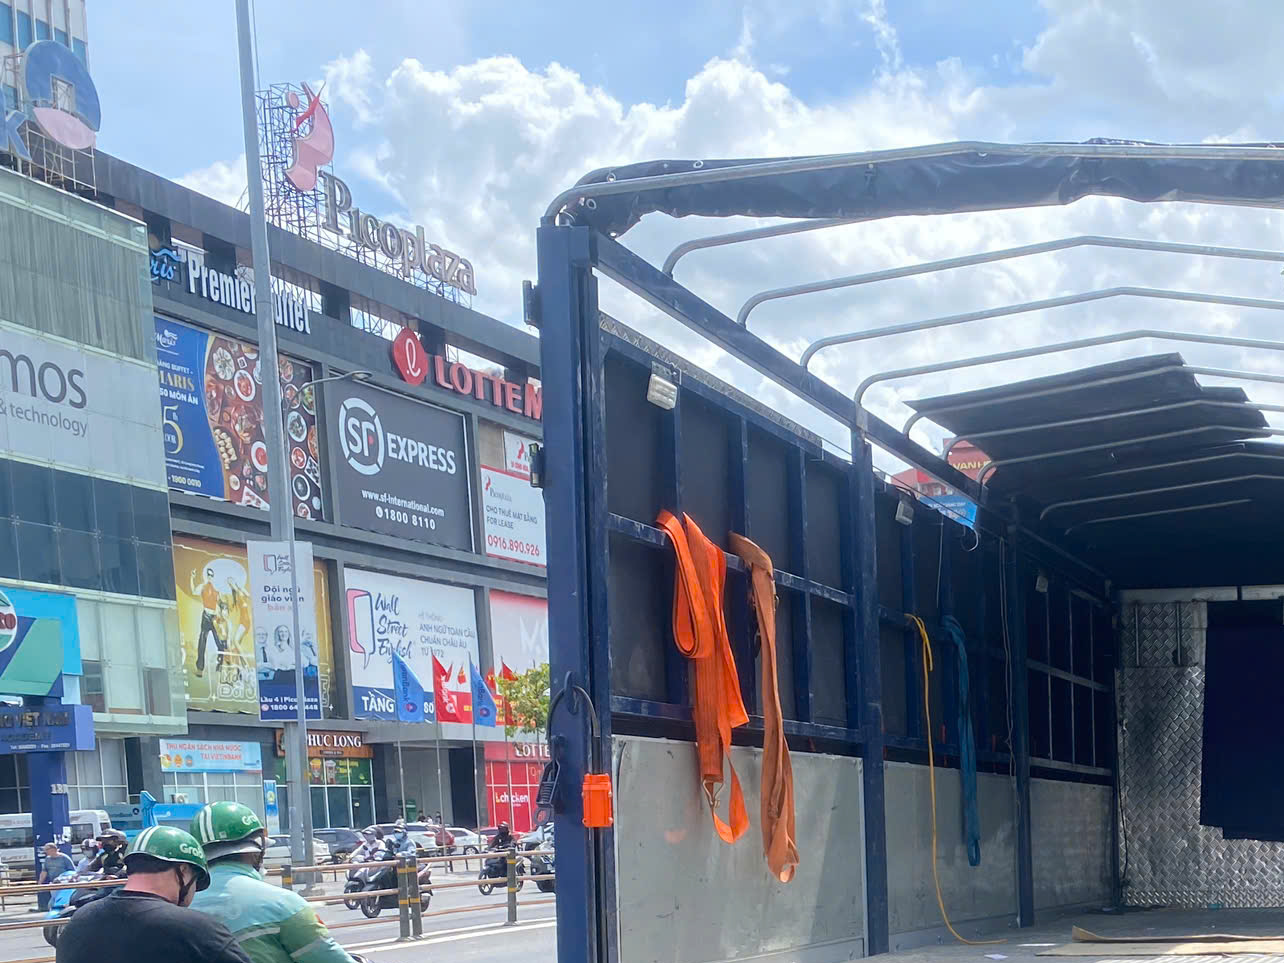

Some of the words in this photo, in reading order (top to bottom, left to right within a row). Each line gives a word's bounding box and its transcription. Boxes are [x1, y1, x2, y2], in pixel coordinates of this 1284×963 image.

[318, 170, 477, 295] Picoplaza
[274, 286, 311, 334] uffet
[10, 403, 88, 438] technology
[387, 432, 456, 474] EXPRESS
[384, 508, 408, 524] 1800
[411, 512, 436, 530] 8110
[375, 592, 399, 616] Wall
[377, 614, 408, 638] Street
[308, 734, 331, 747] HUC
[333, 735, 361, 748] LONG
